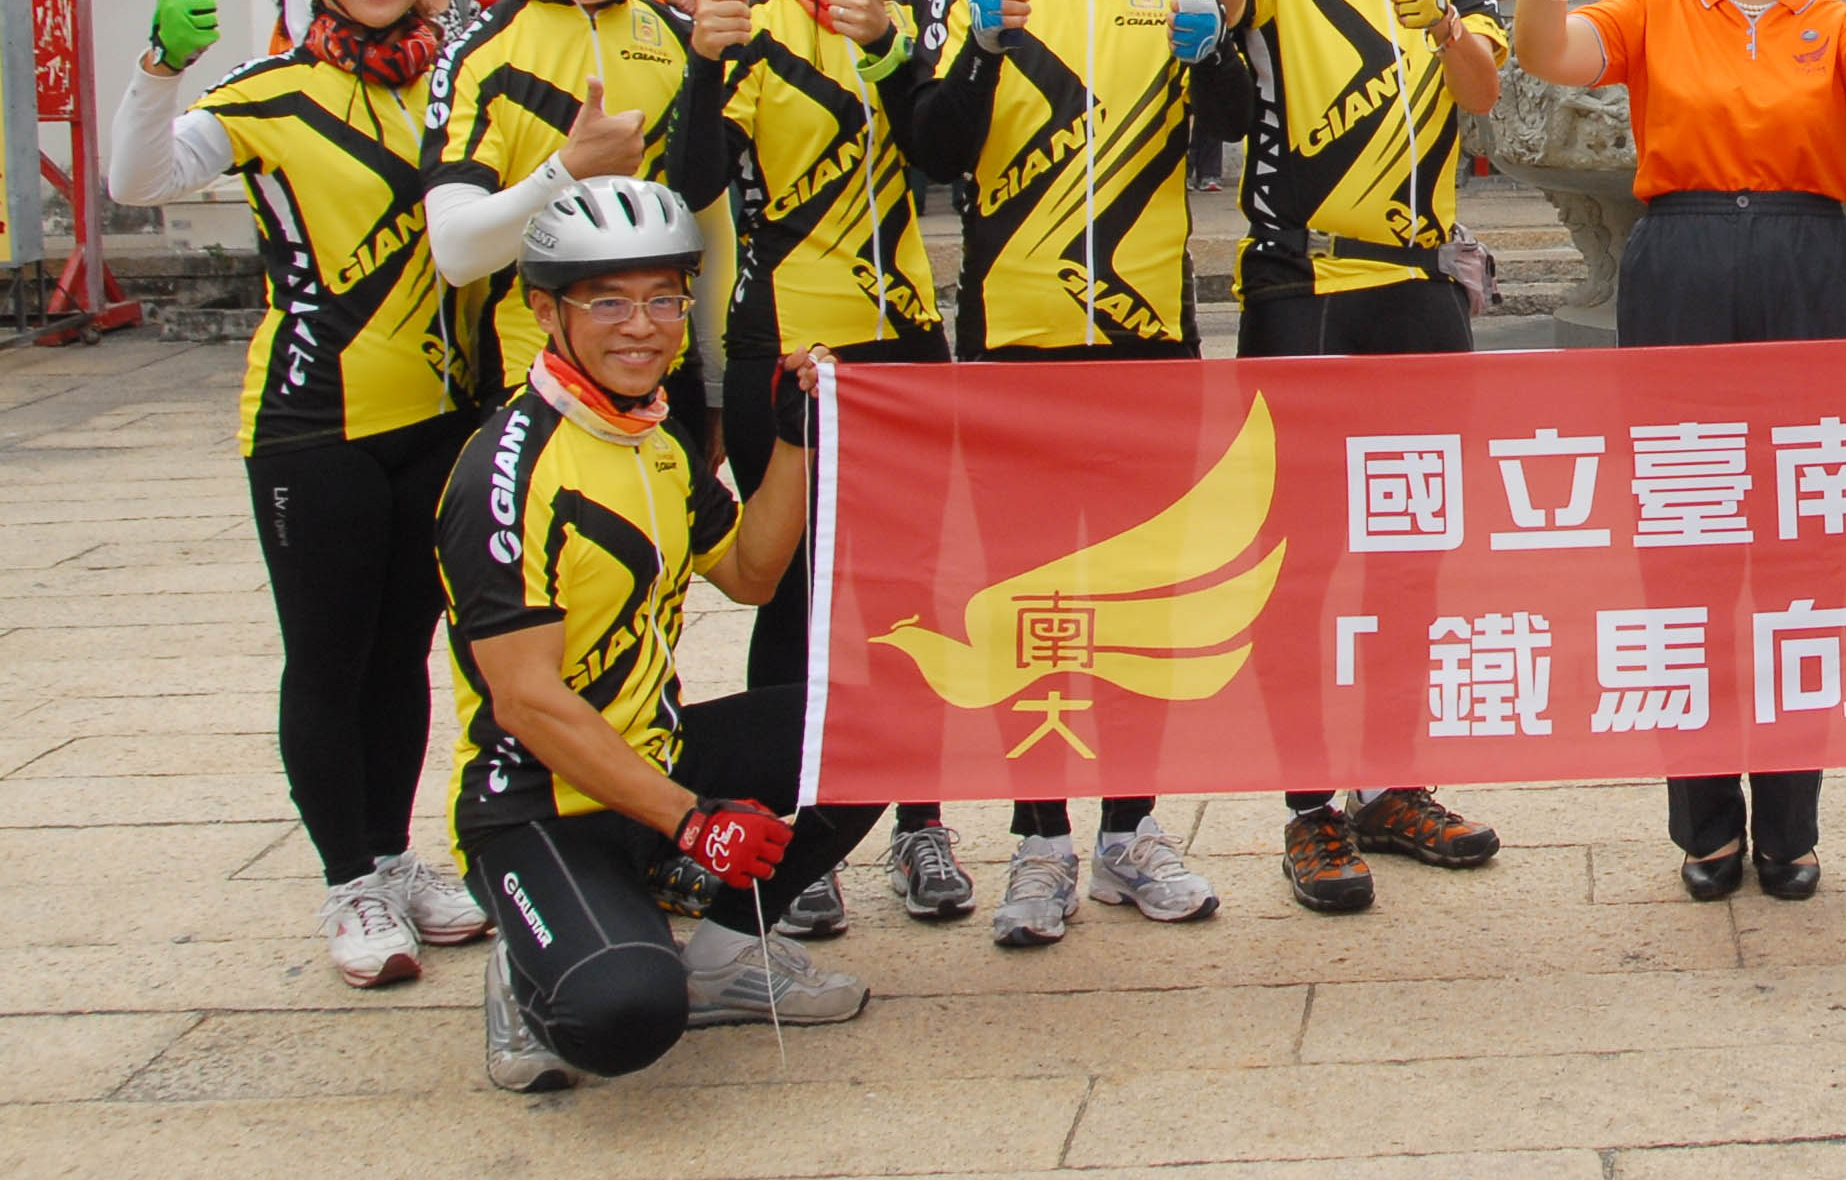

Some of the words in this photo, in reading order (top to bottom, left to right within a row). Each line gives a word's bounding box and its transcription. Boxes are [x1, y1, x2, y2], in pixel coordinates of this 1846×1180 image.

[632, 51, 674, 67] GIANT
[1126, 17, 1167, 27] GIAN
[1301, 60, 1412, 158] GIANT
[764, 119, 874, 220] GIANT
[978, 102, 1108, 218] GIANT
[336, 201, 426, 296] GIAN
[490, 409, 532, 526] GIANT
